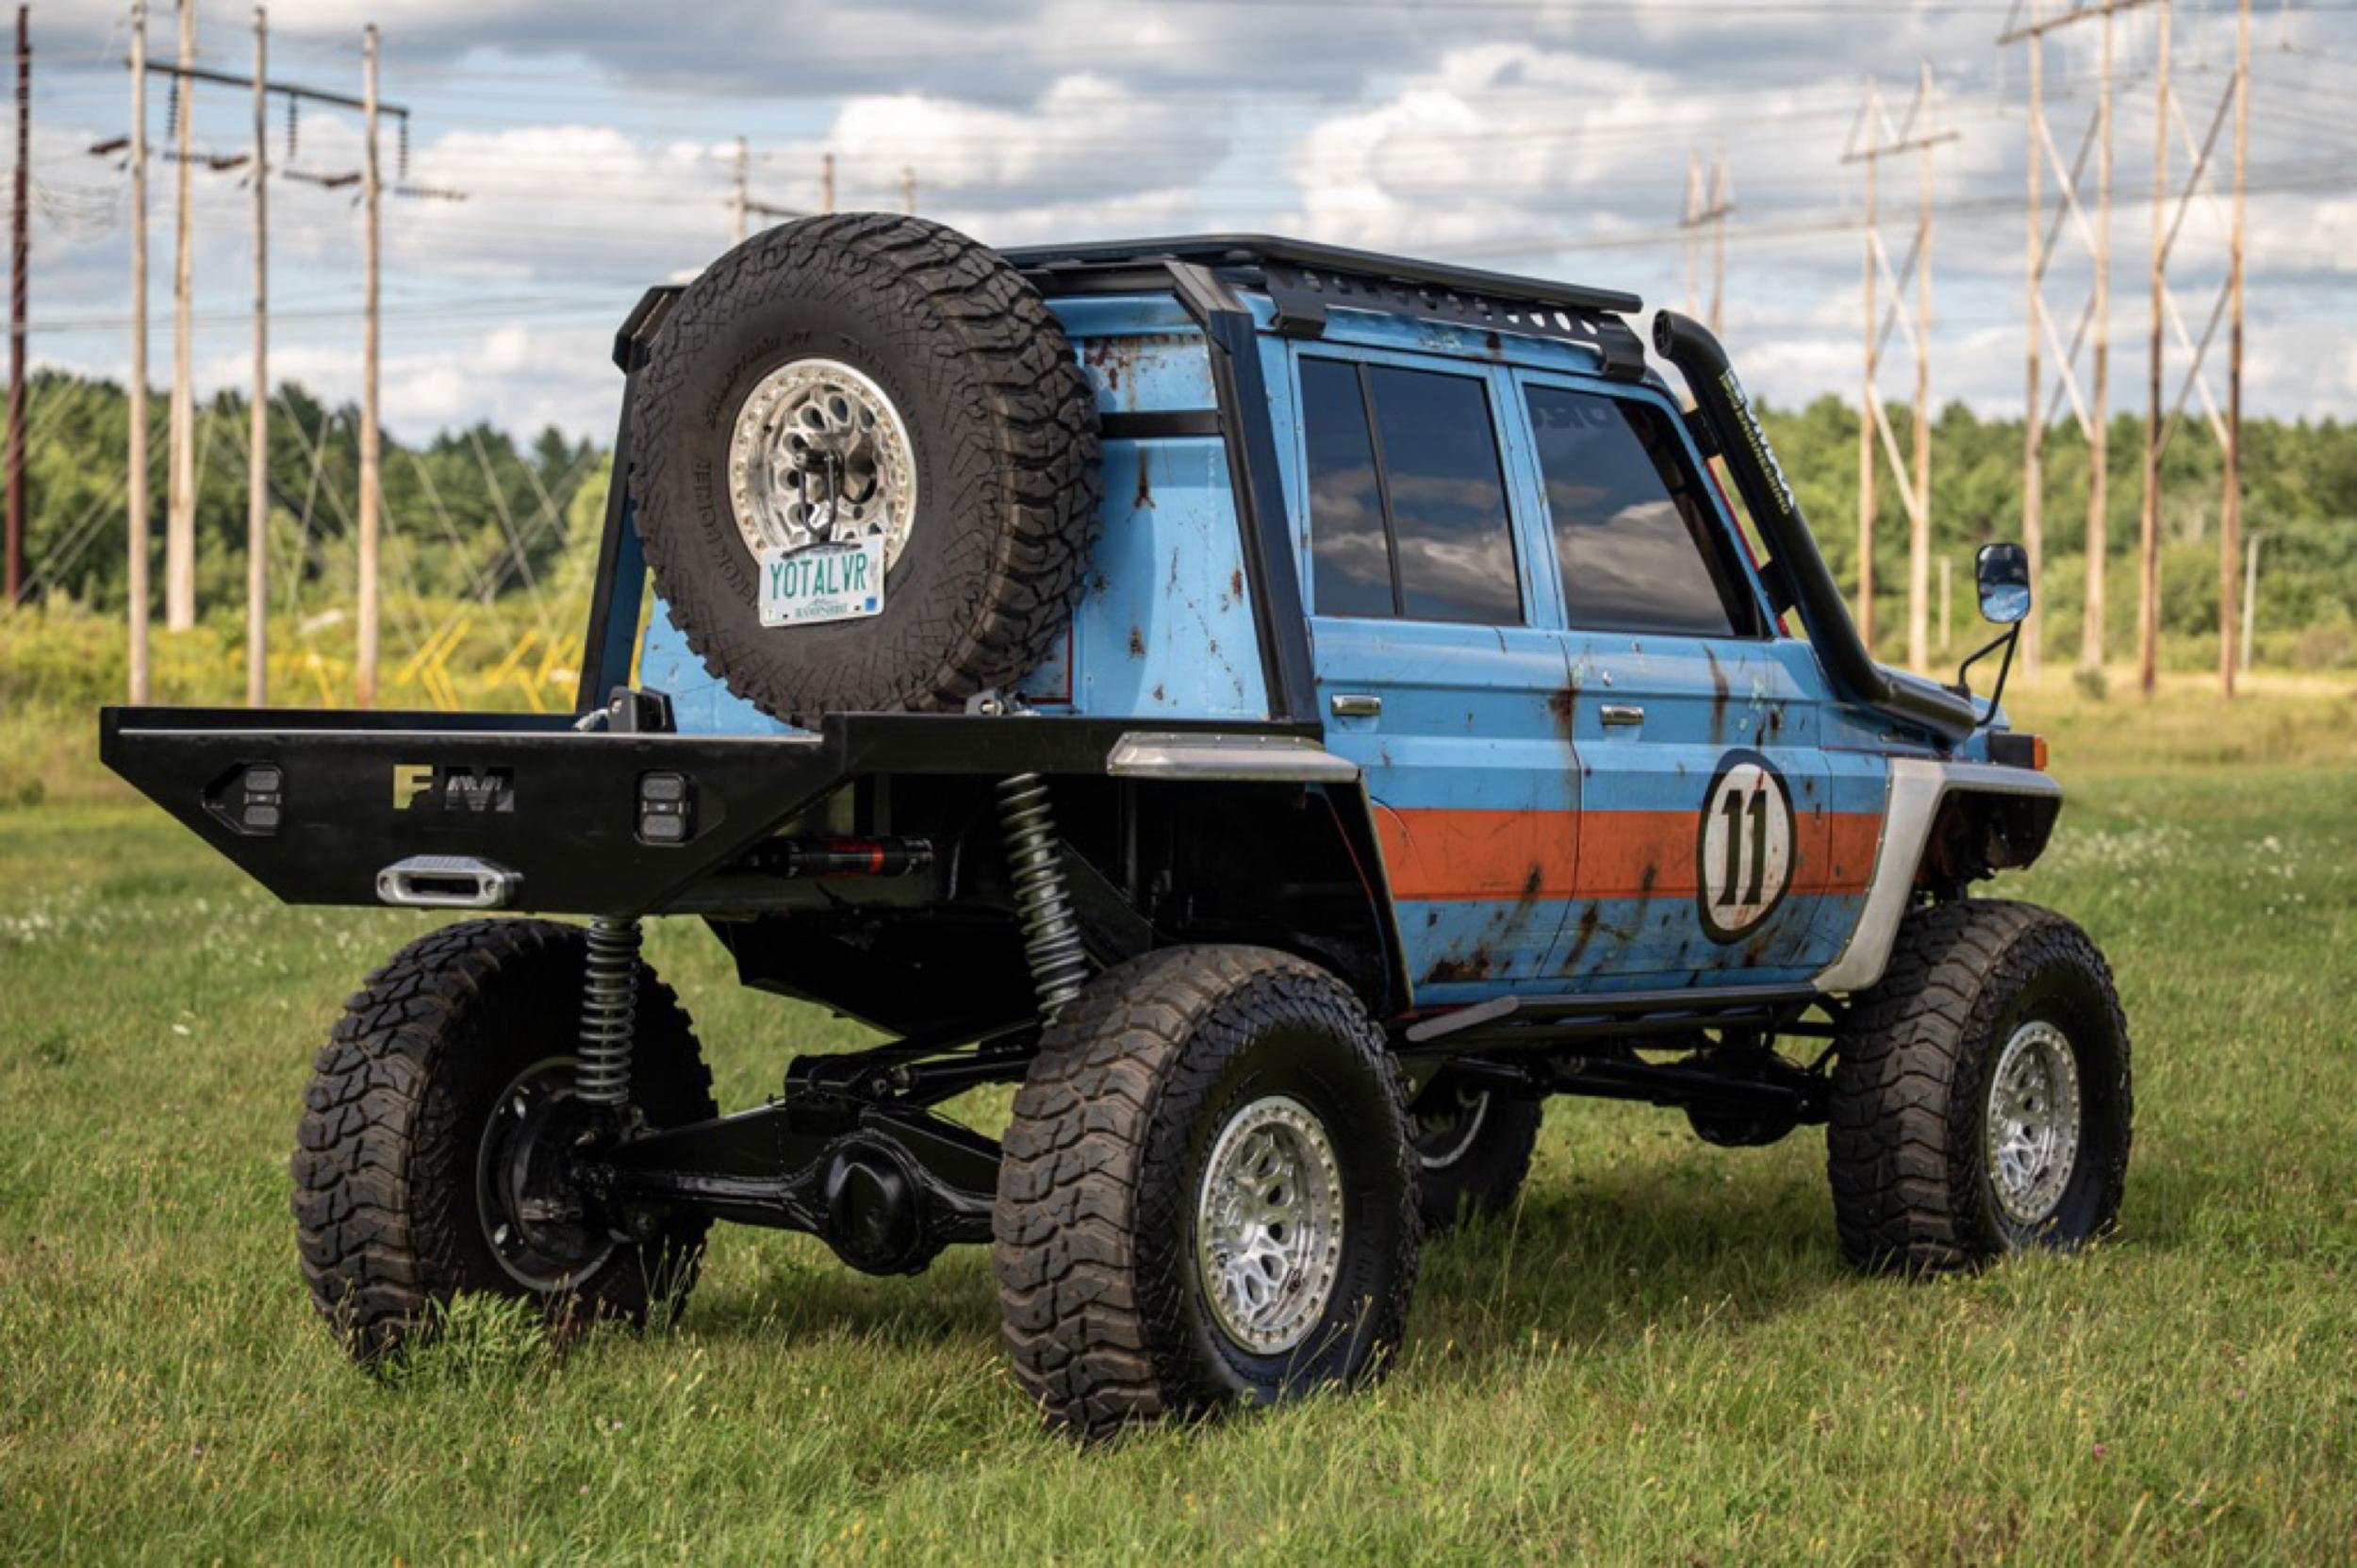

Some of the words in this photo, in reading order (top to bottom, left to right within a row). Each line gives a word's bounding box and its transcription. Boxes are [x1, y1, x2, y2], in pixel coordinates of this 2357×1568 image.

[770, 553, 867, 600] YOTALVR
[393, 764, 515, 812] FM
[1717, 789, 1767, 905] 11
